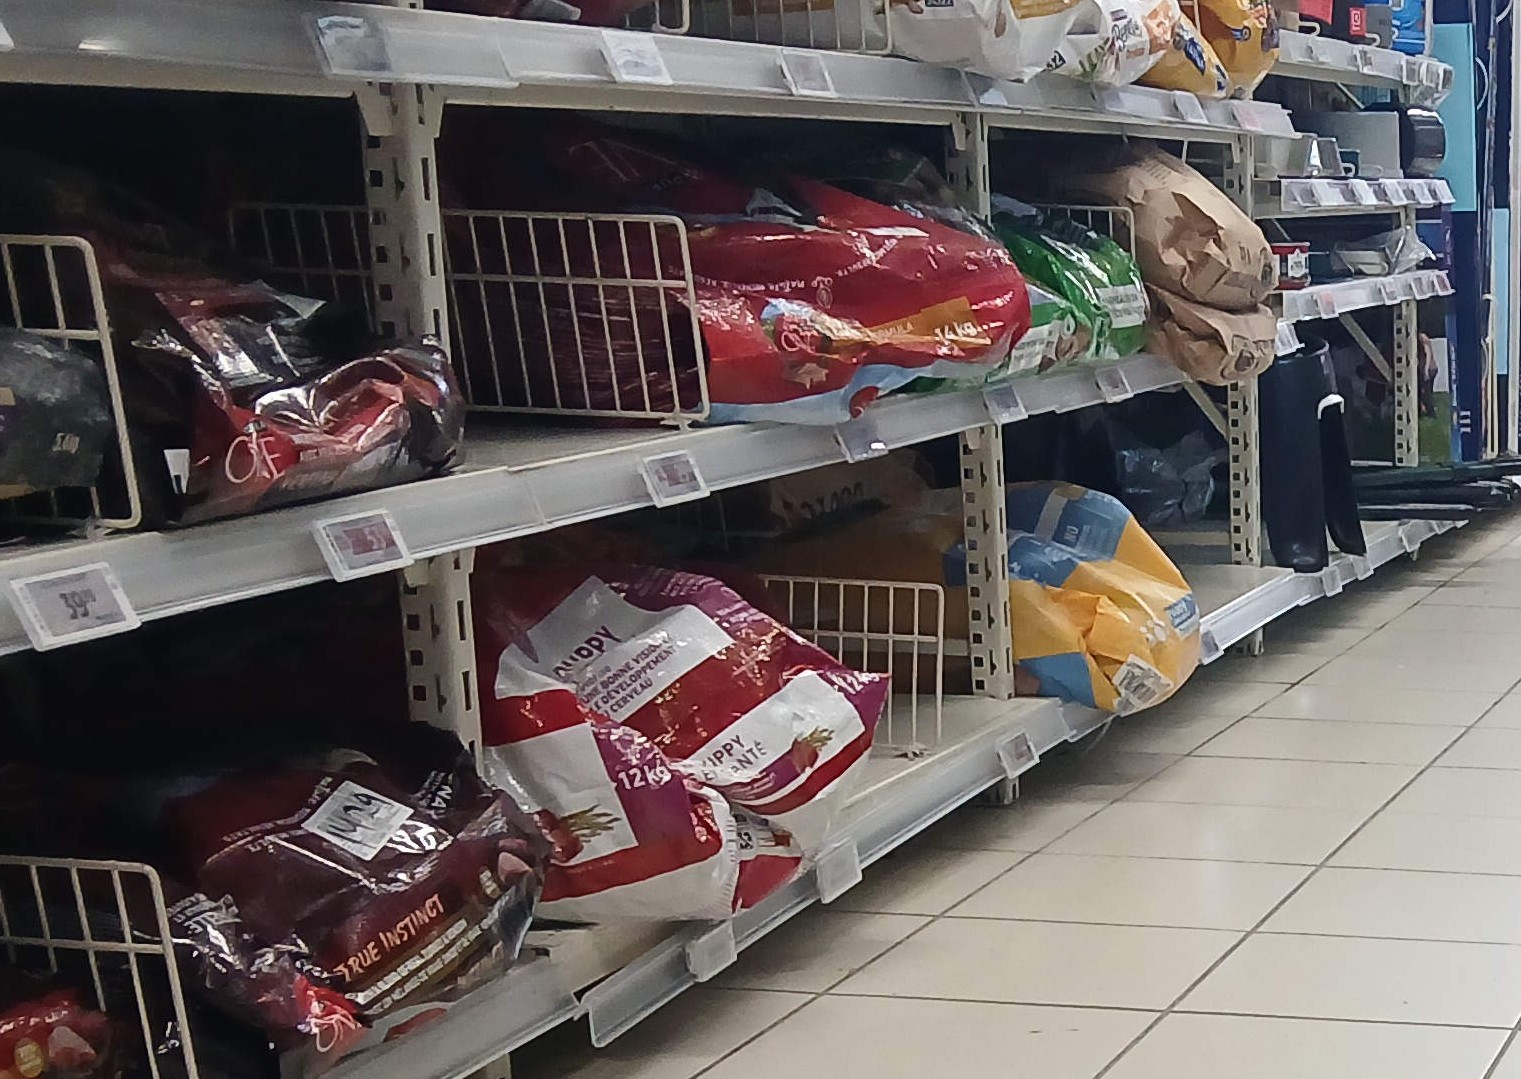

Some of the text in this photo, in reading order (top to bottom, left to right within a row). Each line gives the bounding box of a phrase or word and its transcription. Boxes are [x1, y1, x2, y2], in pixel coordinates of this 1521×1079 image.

[600, 661, 635, 690] BONNE
[610, 678, 653, 713] CERVEAU
[616, 756, 672, 790] 12kg
[334, 941, 382, 983] TRUE
[379, 894, 444, 951] INSTINCT
